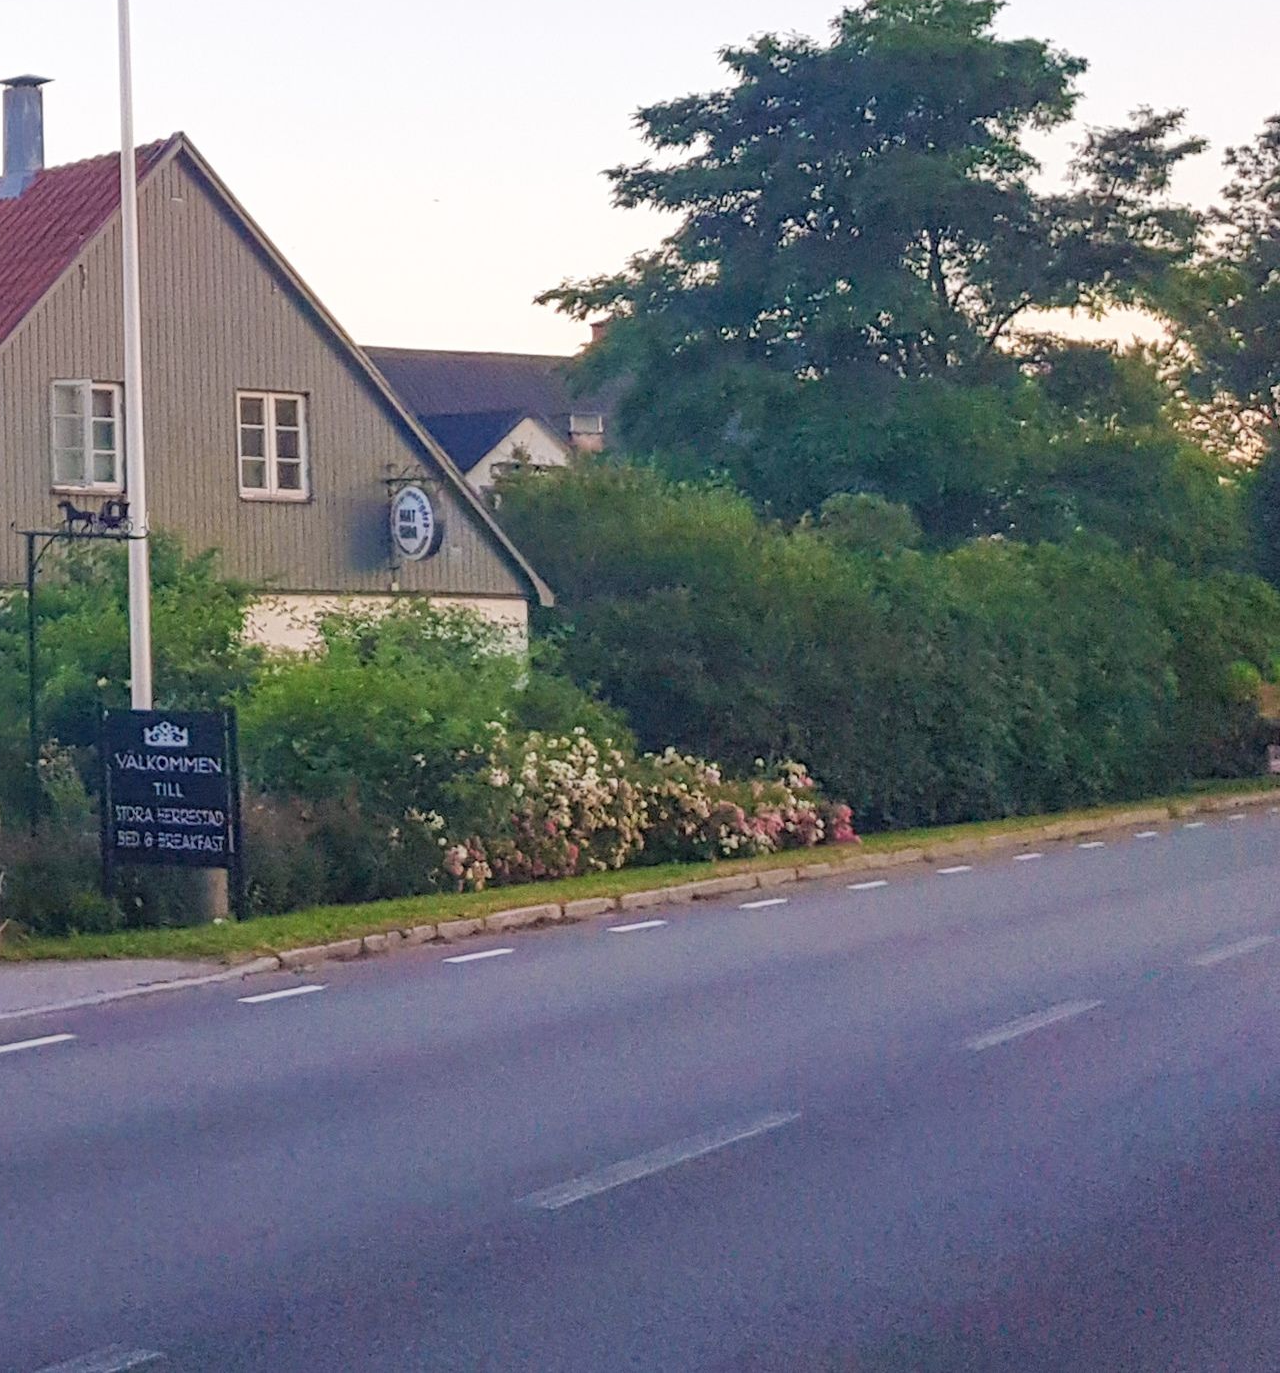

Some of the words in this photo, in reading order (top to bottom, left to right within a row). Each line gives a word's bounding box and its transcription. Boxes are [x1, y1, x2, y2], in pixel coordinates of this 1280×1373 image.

[115, 751, 222, 773] VÄLKOMMEN
[153, 782, 184, 798] TILL
[115, 805, 155, 823] STORA
[157, 807, 224, 826] HERRESTAD
[117, 830, 140, 847] BED
[157, 831, 225, 852] BREAKFAST
